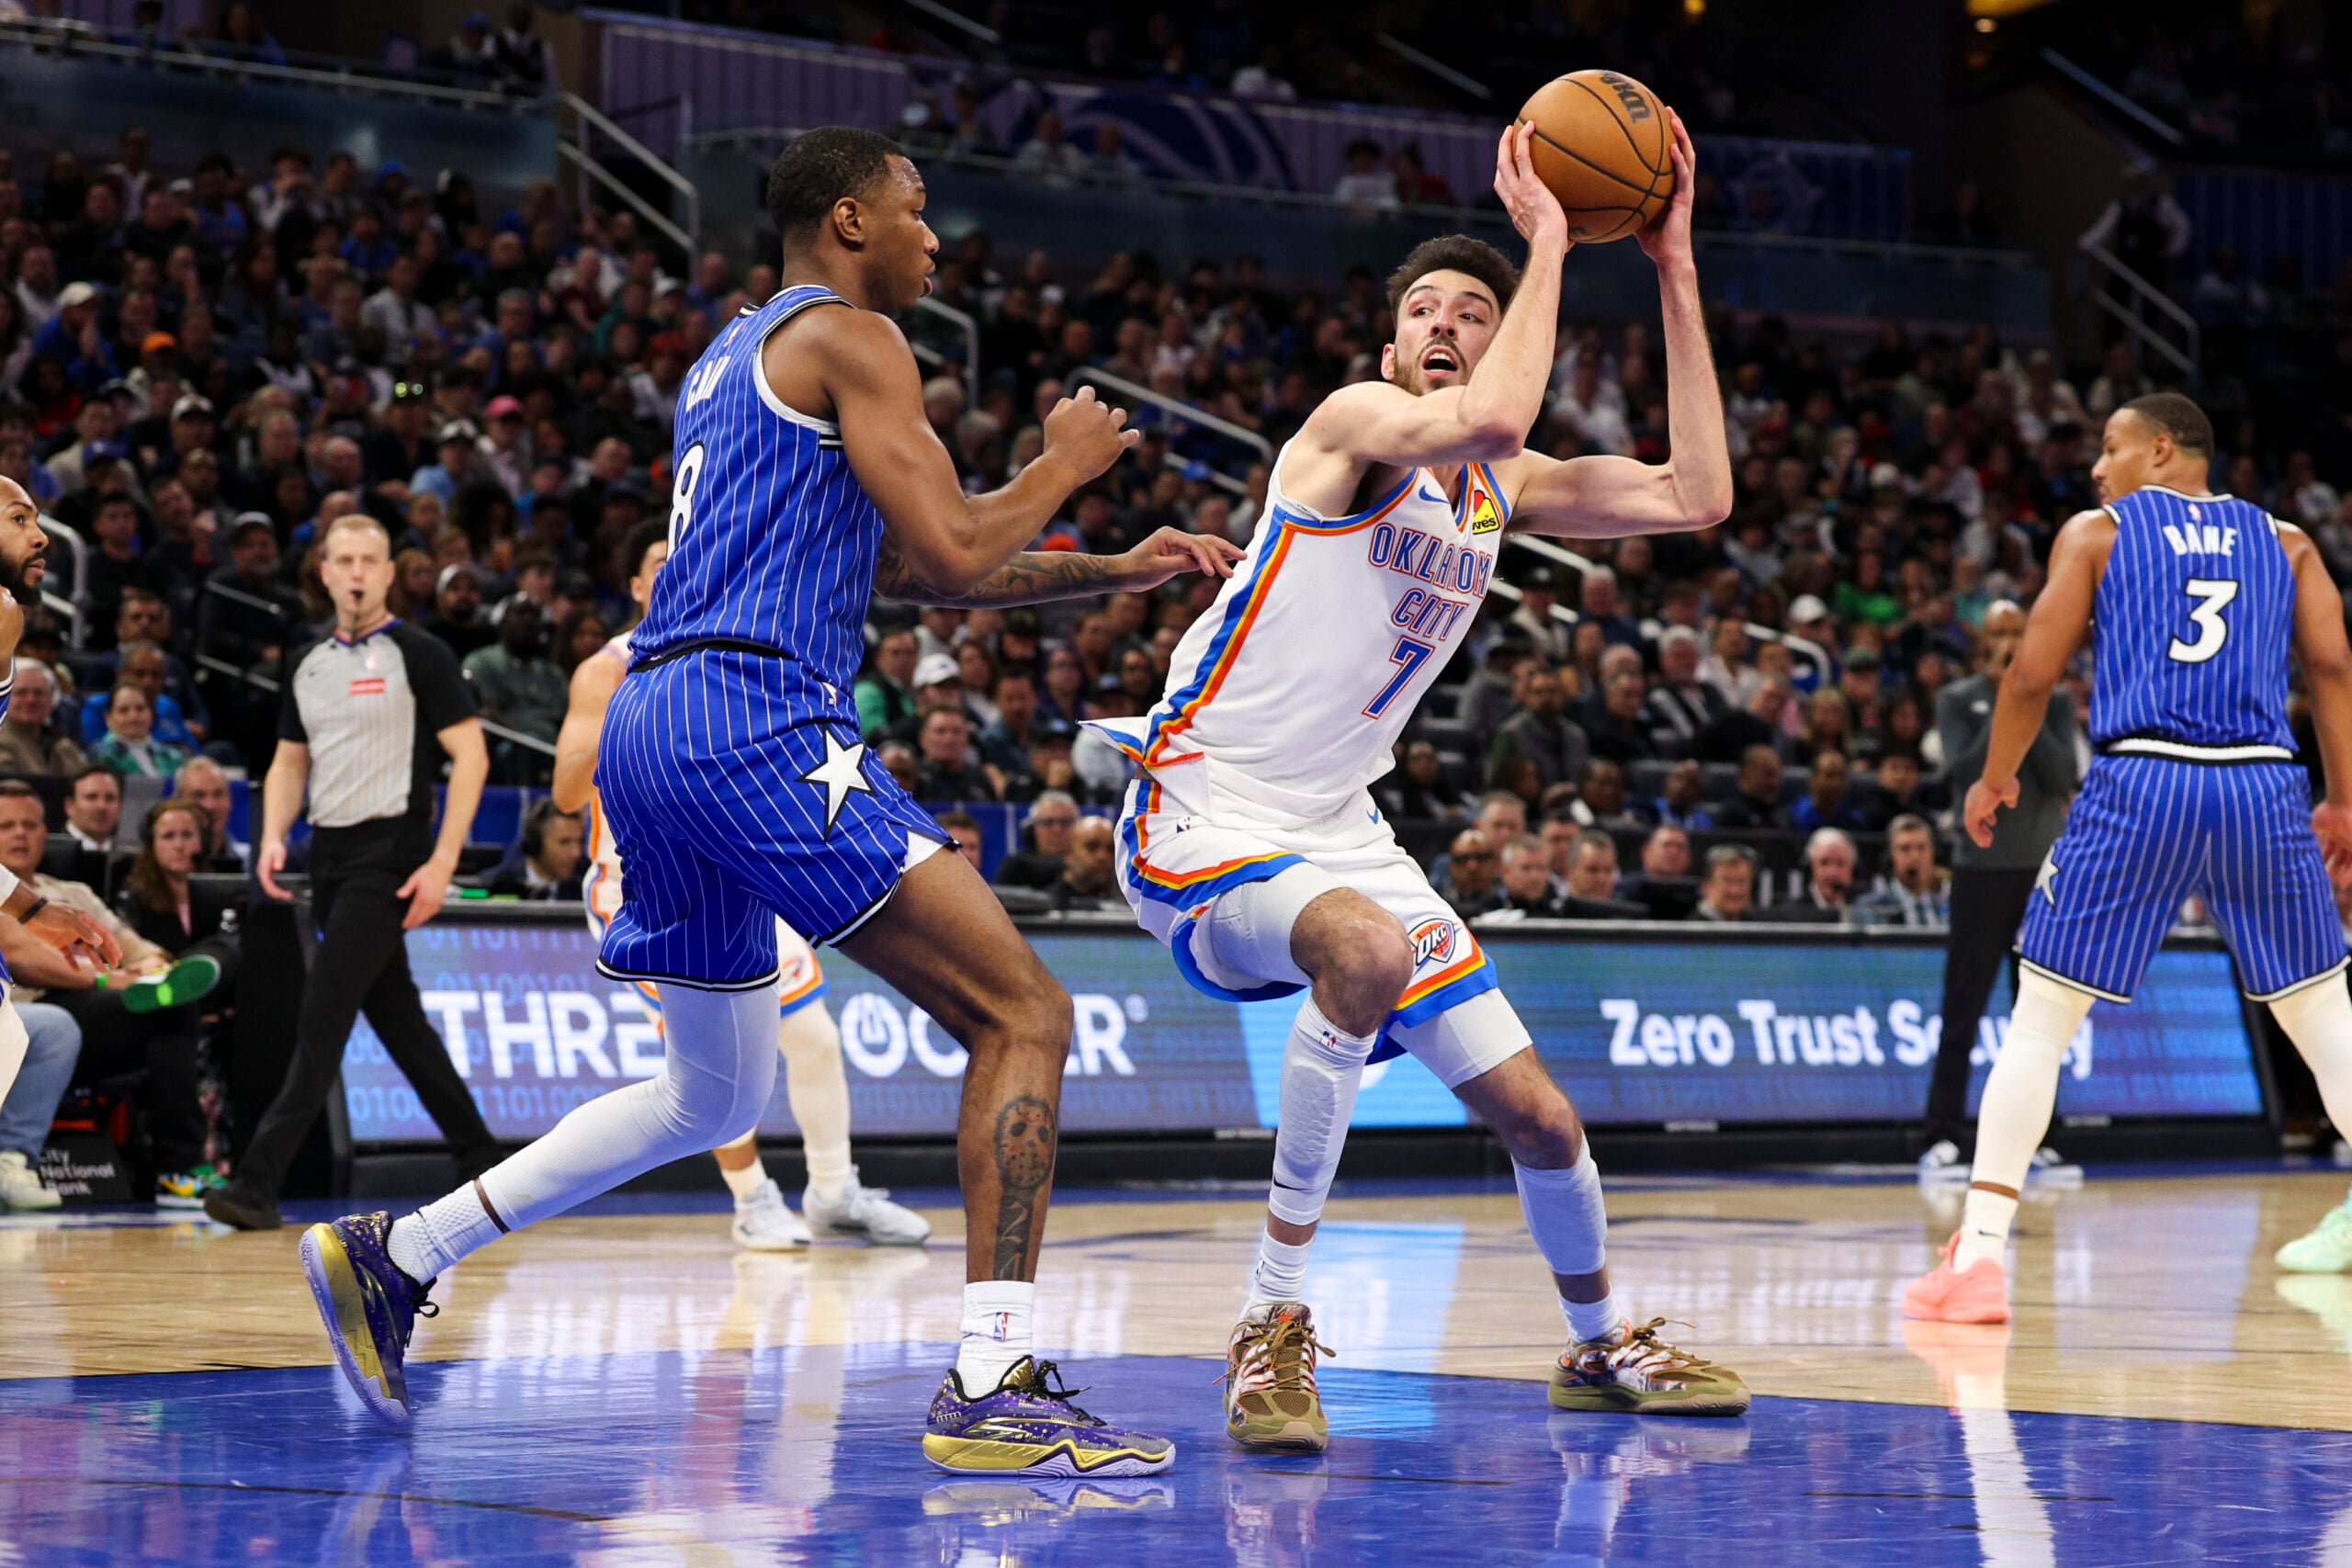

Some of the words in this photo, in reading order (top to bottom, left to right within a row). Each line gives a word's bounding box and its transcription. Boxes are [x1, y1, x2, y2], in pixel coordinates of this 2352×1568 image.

[667, 442, 705, 561] 8
[2162, 523, 2237, 558] BANE
[1391, 588, 1469, 641] CITY
[2168, 578, 2240, 663] 3
[1362, 636, 1436, 720] 7
[1415, 924, 1448, 966] OKC
[1600, 998, 1735, 1066] Zero
[1737, 998, 1885, 1066] Trust
[40, 1162, 115, 1178] National
